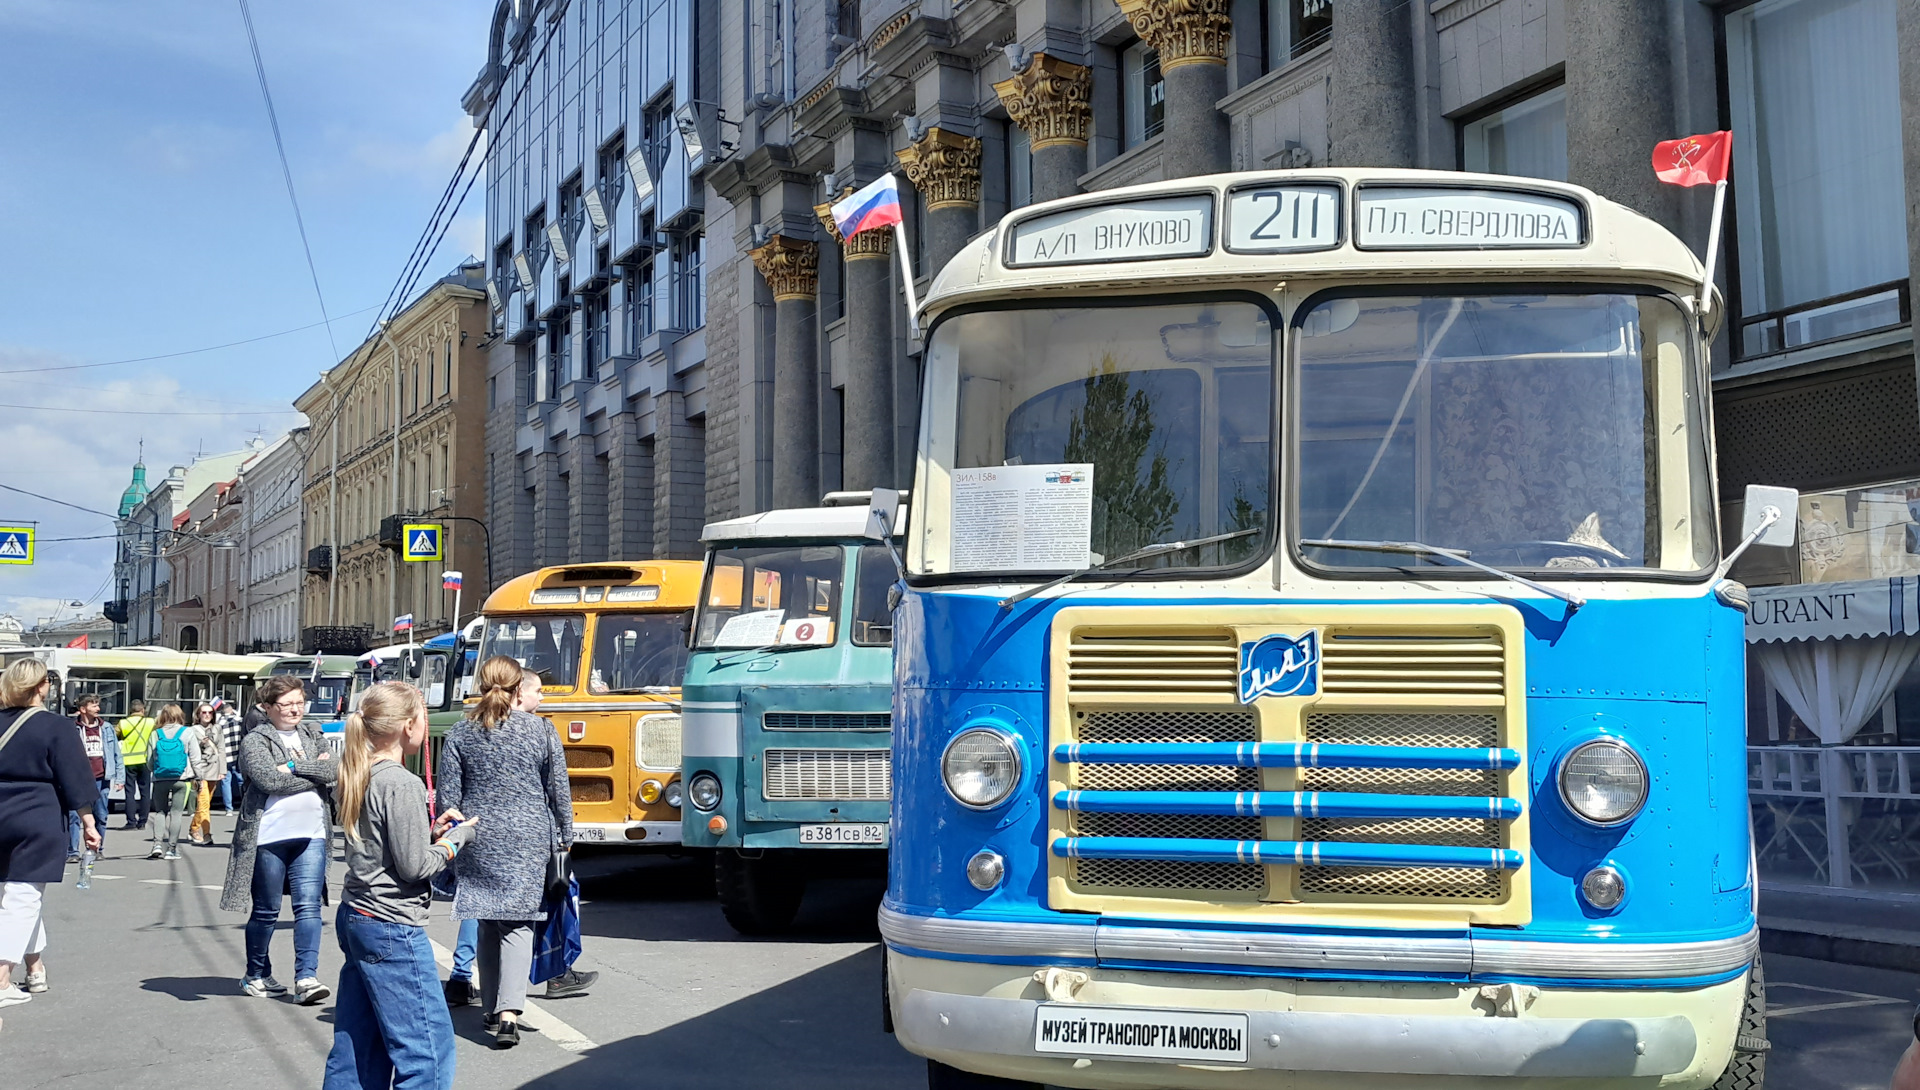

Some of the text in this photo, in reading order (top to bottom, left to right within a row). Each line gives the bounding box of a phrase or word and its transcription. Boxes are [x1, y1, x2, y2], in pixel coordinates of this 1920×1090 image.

[1250, 190, 1319, 240] 211
[1421, 208, 1568, 240] СВЕРДЛОВА
[1095, 218, 1191, 251] ВНУКОВО
[1745, 593, 1855, 626] URANT
[800, 625, 809, 639] 2
[587, 829, 603, 838] 198
[806, 826, 878, 841] В381СВ 82
[1042, 1017, 1241, 1051] МУЗЕЙ ТРАНСПОРТА МОСКВЫ
